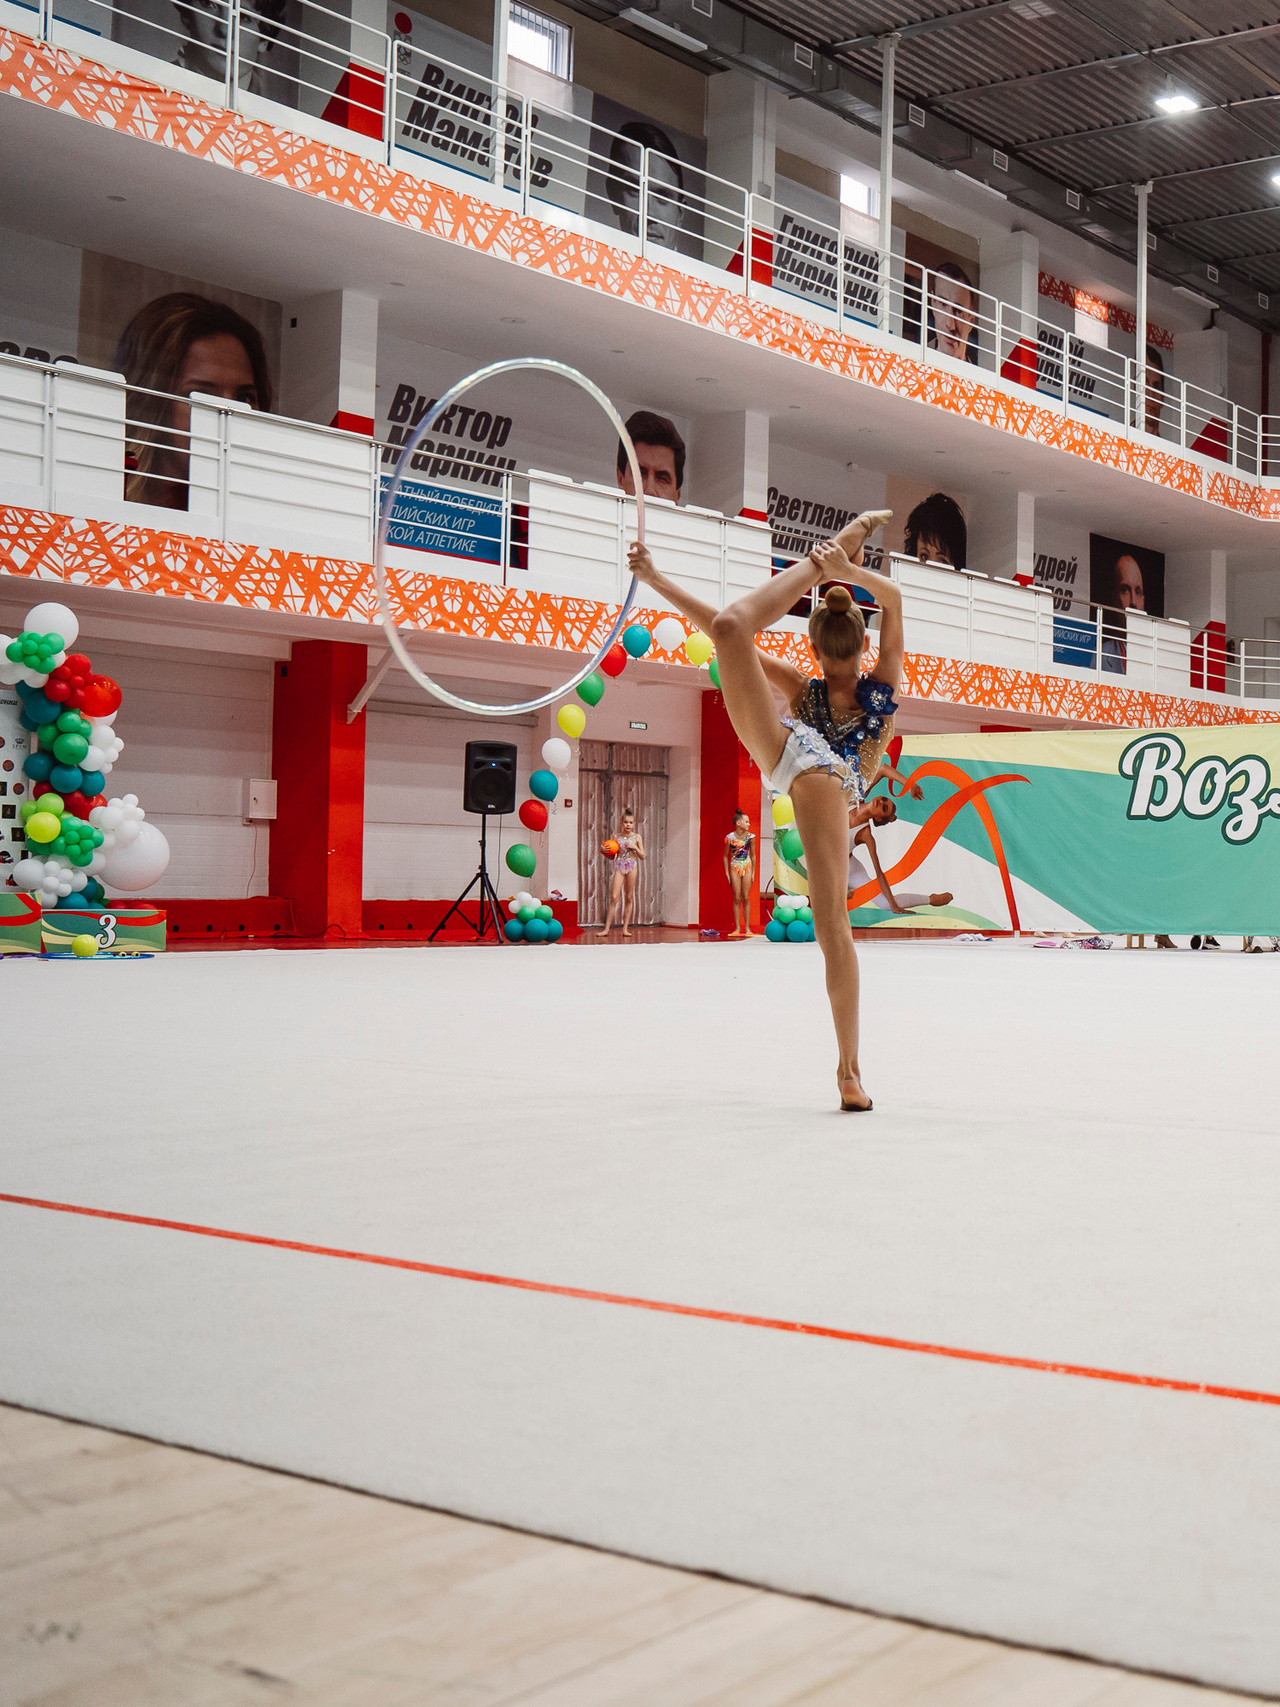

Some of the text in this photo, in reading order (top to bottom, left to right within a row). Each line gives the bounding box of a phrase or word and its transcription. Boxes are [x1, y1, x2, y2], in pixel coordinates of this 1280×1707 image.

[776, 214, 879, 283] Григорий
[387, 384, 512, 449] Виктор
[381, 425, 517, 489] Маркин
[391, 503, 476, 532] ПИЙСКИХ ИГР
[415, 530, 478, 554] АТЛЕТИКЕ
[1034, 553, 1078, 585] дрей
[95, 913, 117, 949] 3
